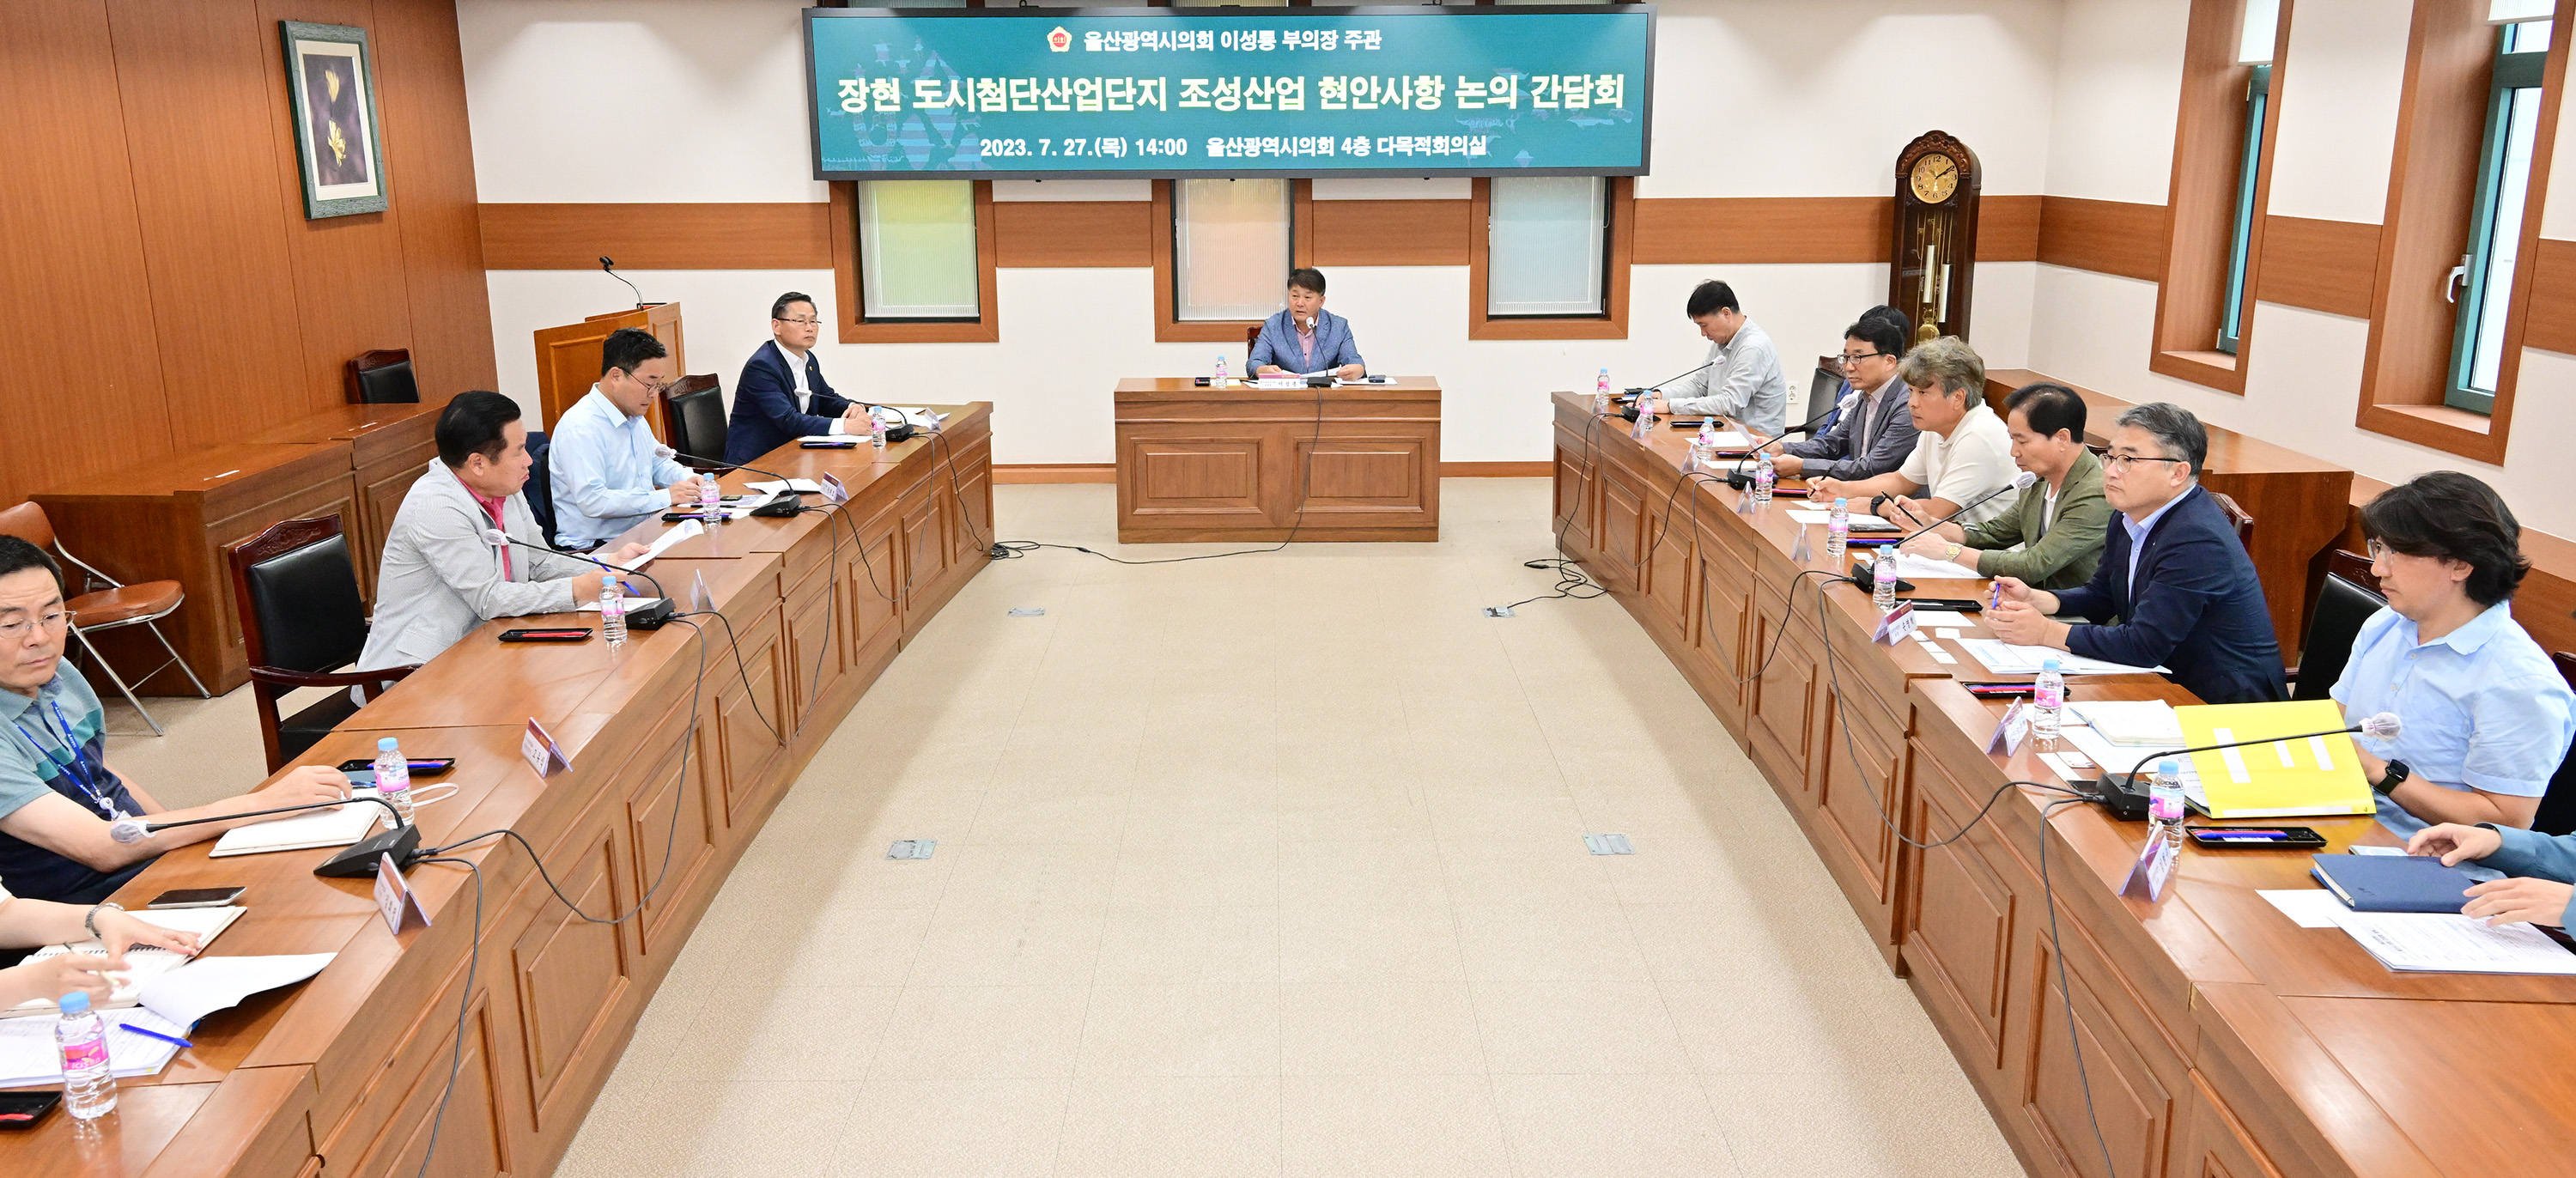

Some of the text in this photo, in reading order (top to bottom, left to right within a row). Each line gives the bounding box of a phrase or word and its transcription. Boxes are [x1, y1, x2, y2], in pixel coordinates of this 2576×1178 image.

[1084, 29, 1382, 52] 울산광역시의회 이성룡 부의장 주관
[837, 74, 1625, 112] 장현 도시첨단산업단지 조성산업 현안사항 논의 간담회
[980, 135, 1487, 158] 2023. 7. 27.(목) 14:00 울산광역시의회 4층 다목적회의실
